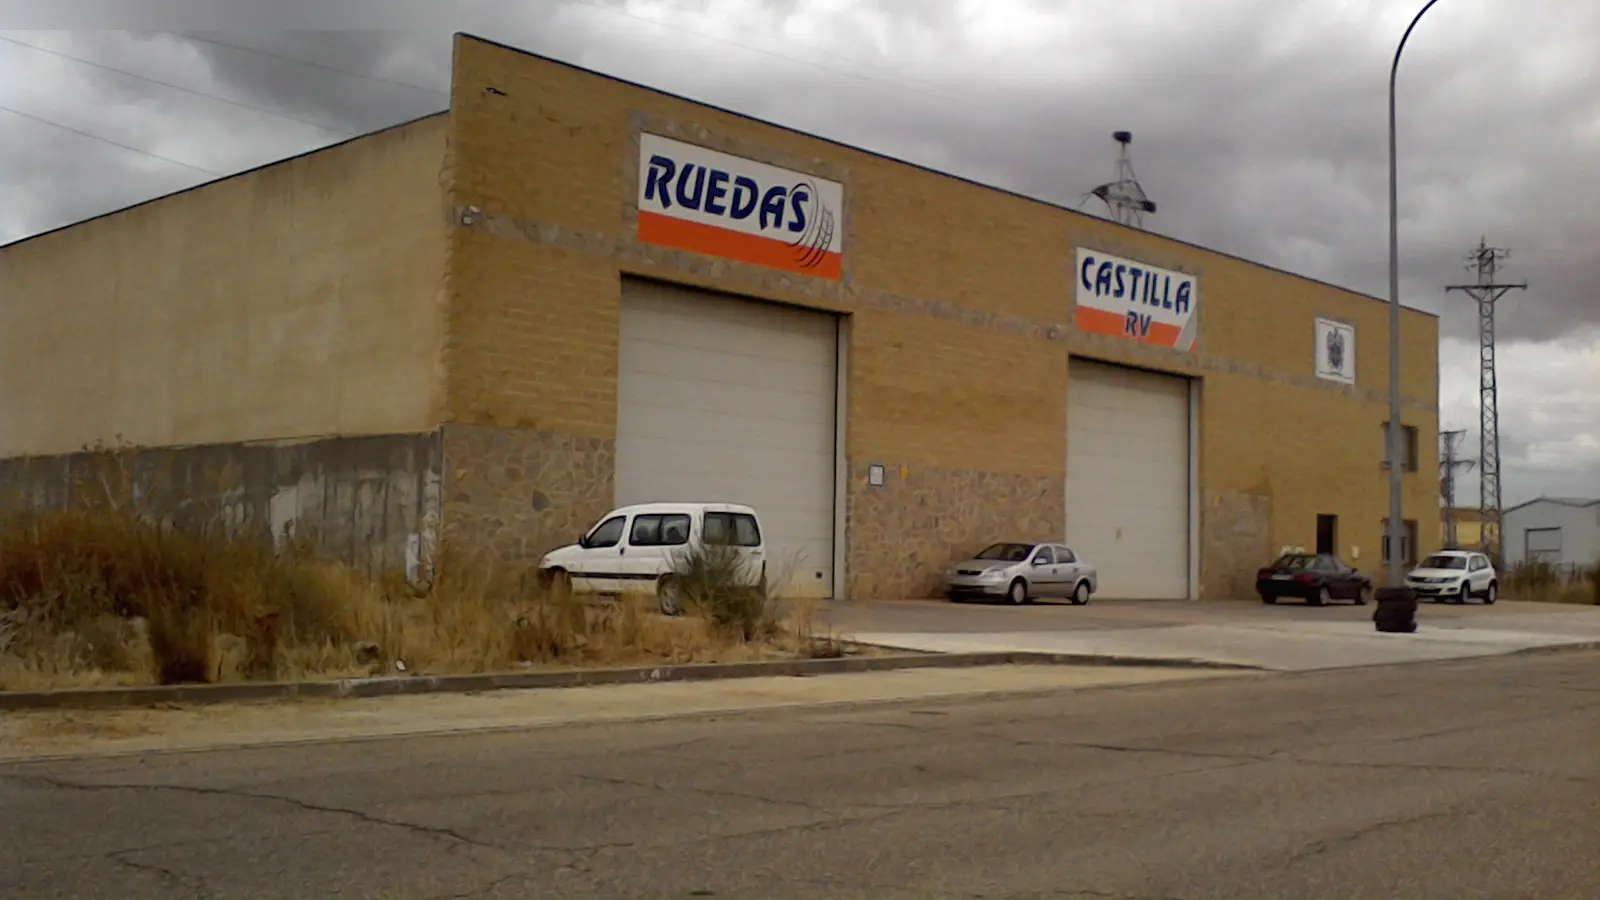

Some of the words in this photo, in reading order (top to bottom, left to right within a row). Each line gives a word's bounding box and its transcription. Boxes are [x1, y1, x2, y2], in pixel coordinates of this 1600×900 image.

[644, 154, 809, 233] RUEDAS
[1081, 256, 1191, 315] CASTILLA
[1125, 310, 1152, 337] RV
